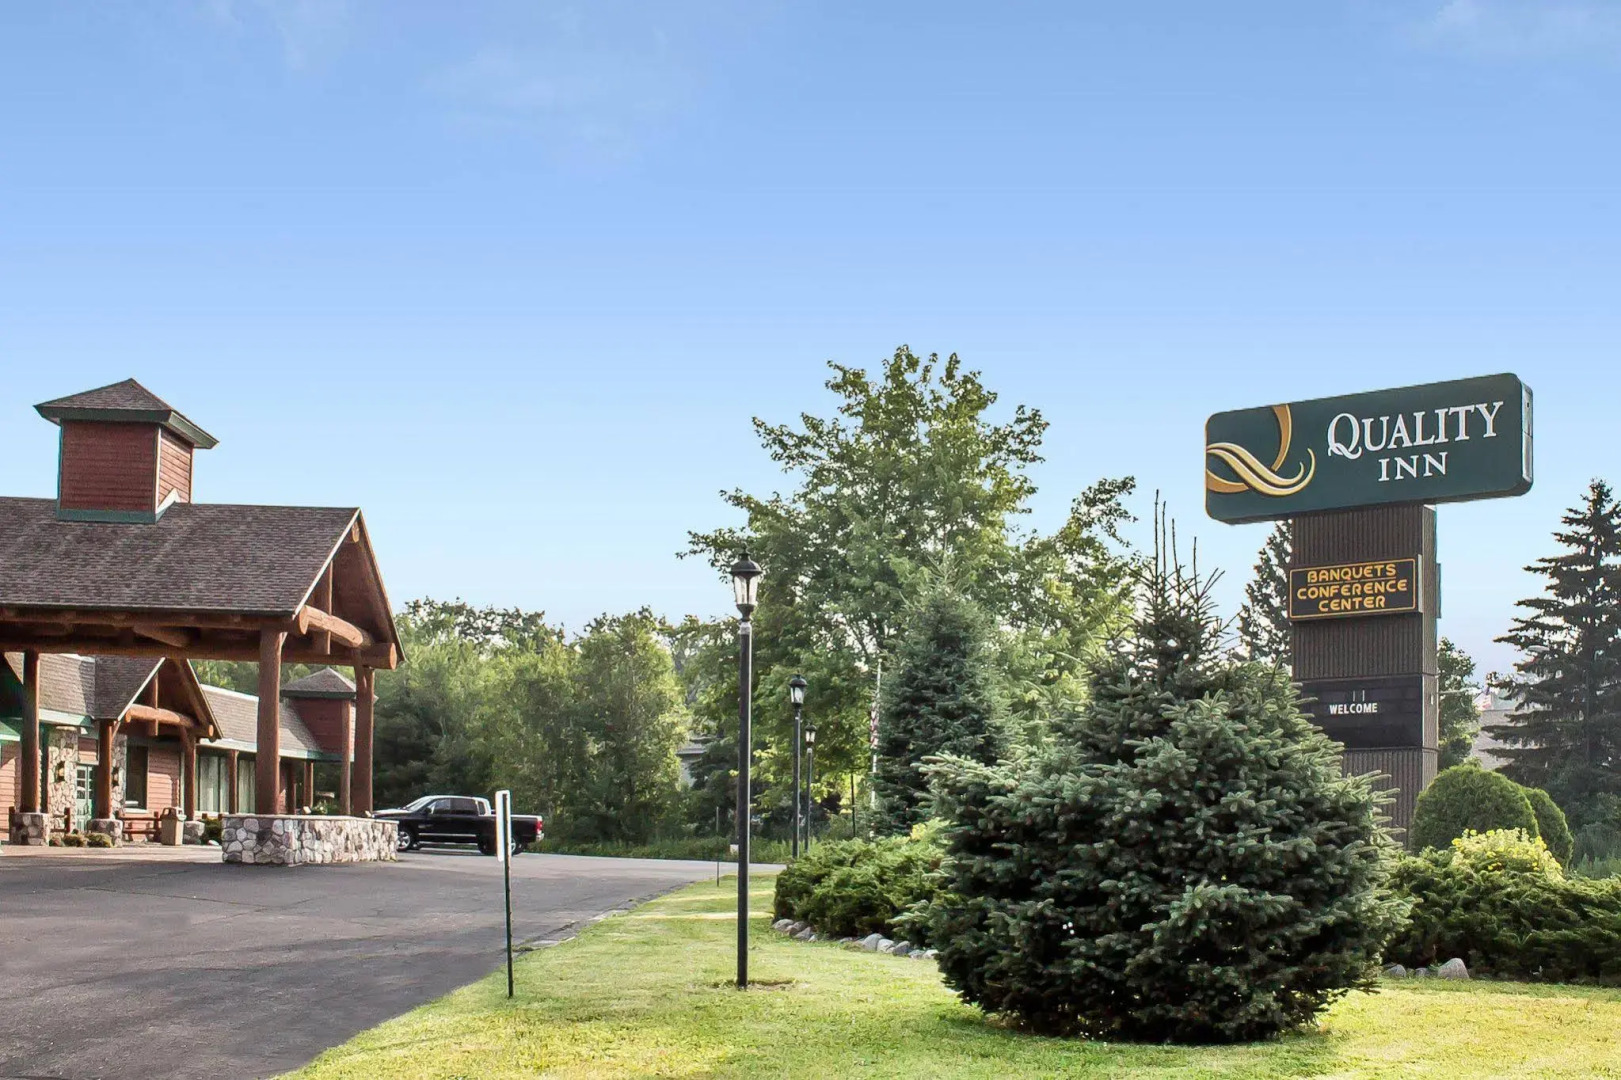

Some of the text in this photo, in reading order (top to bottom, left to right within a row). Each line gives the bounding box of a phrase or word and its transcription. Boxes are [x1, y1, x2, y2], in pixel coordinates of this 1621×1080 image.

[1327, 401, 1504, 460] QUALITY
[1378, 452, 1448, 481] INN
[1307, 564, 1396, 583] BANQUETS
[1297, 579, 1408, 599] CONFERENCE
[1318, 596, 1386, 612] CENTER
[1329, 702, 1378, 715] WELCOME
